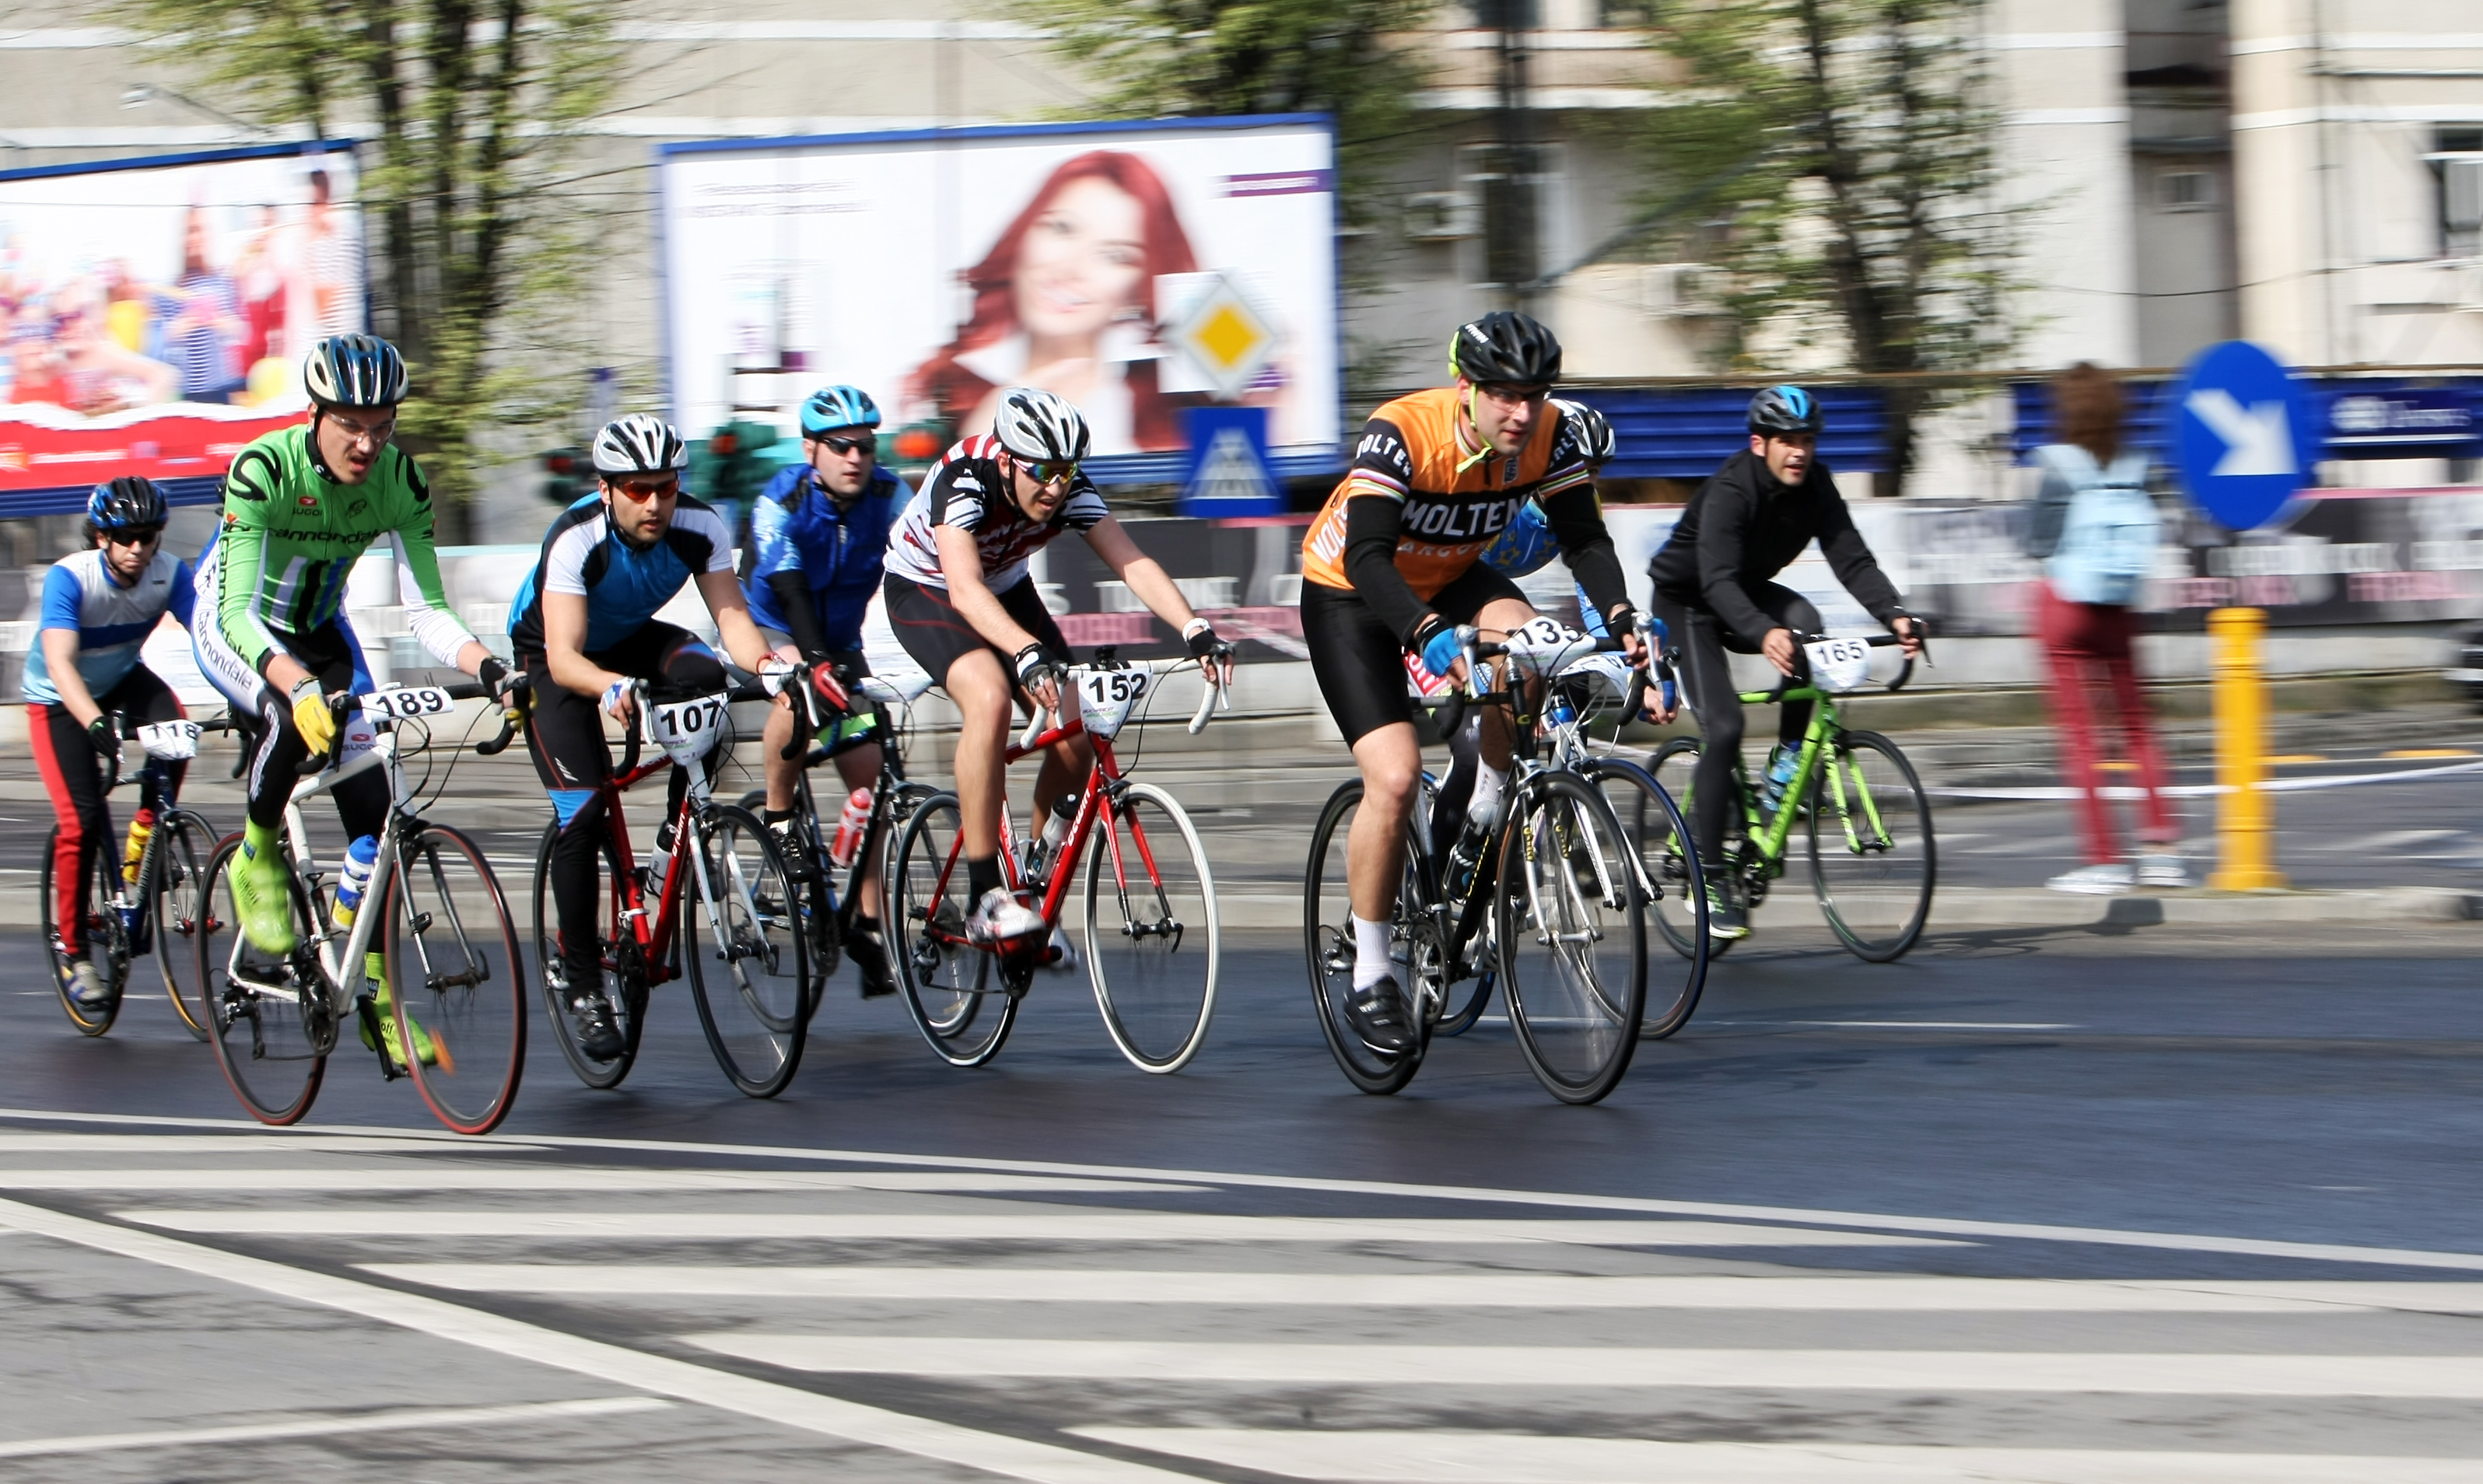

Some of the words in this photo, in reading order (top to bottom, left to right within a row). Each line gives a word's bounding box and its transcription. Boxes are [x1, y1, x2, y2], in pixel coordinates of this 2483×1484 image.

[198, 611, 253, 694] cannondale
[1816, 641, 1864, 664] 165
[1089, 673, 1147, 702] 152
[376, 690, 443, 717] 189
[147, 723, 198, 740] 118
[660, 700, 721, 736] 107
